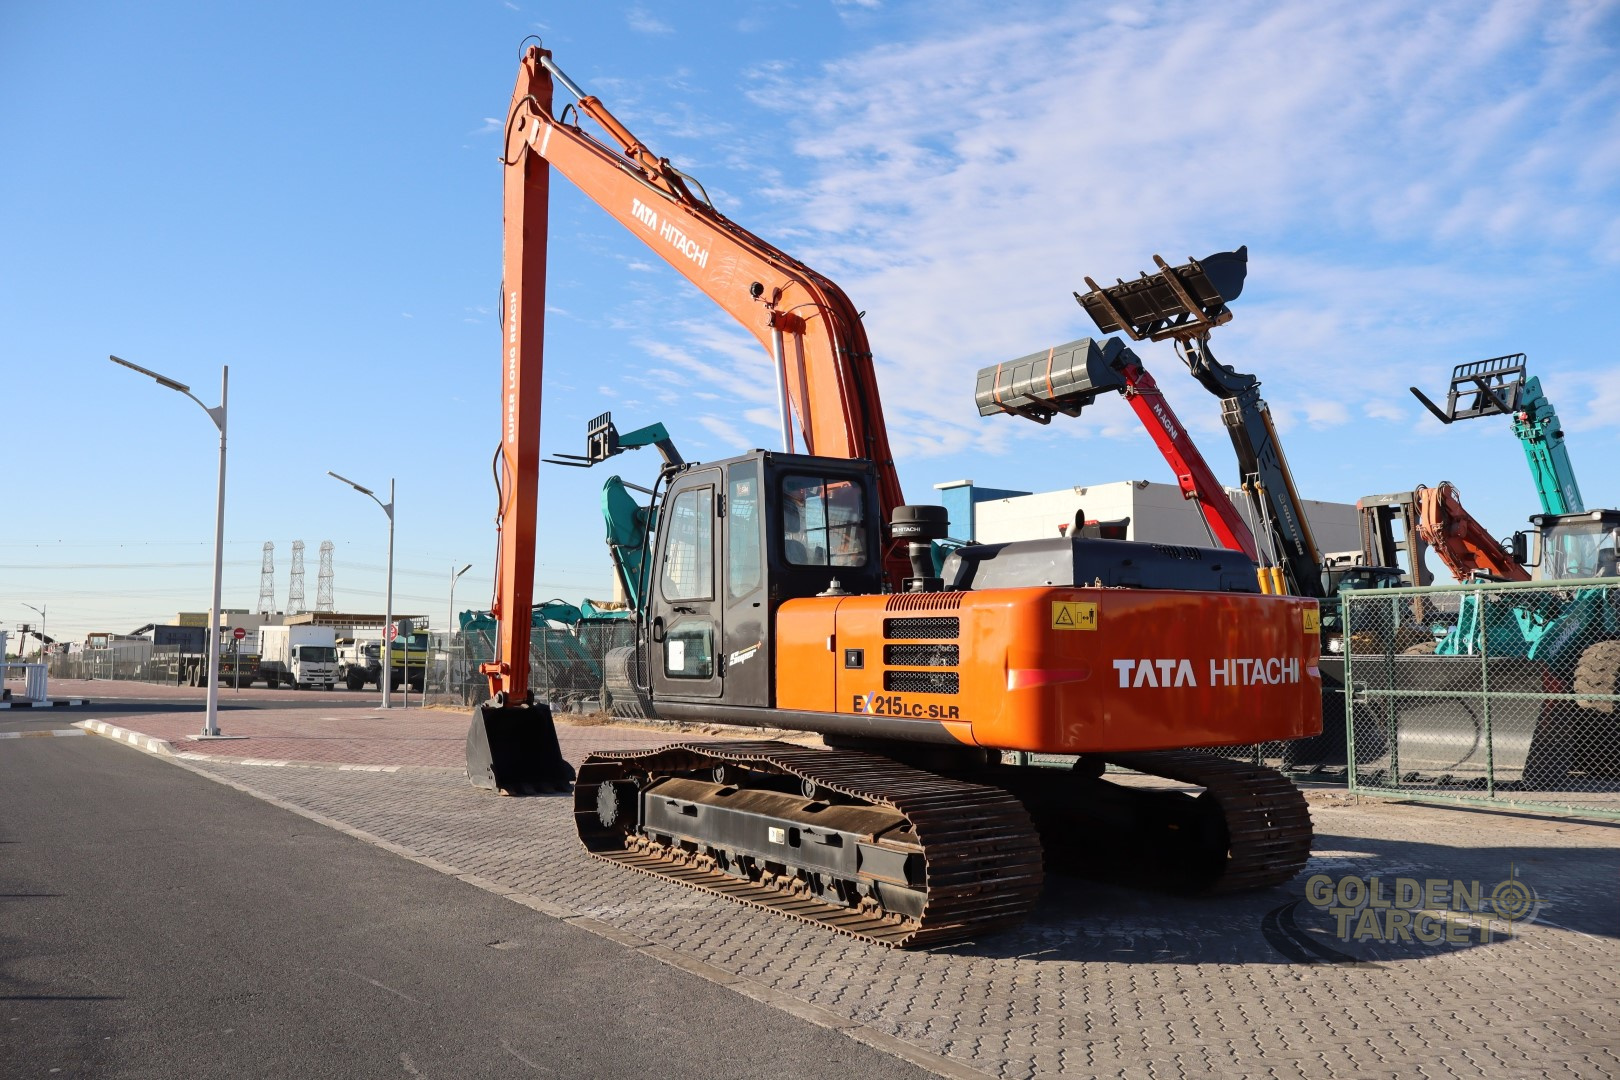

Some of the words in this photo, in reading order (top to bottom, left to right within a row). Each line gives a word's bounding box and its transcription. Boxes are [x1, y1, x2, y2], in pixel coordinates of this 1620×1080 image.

[631, 198, 658, 231] TATA
[660, 219, 709, 269] HITACHI
[508, 393, 516, 444] SUPER
[1153, 403, 1178, 440] MAGNI
[1112, 659, 1197, 688] TATA
[1209, 657, 1299, 687] HITACHI
